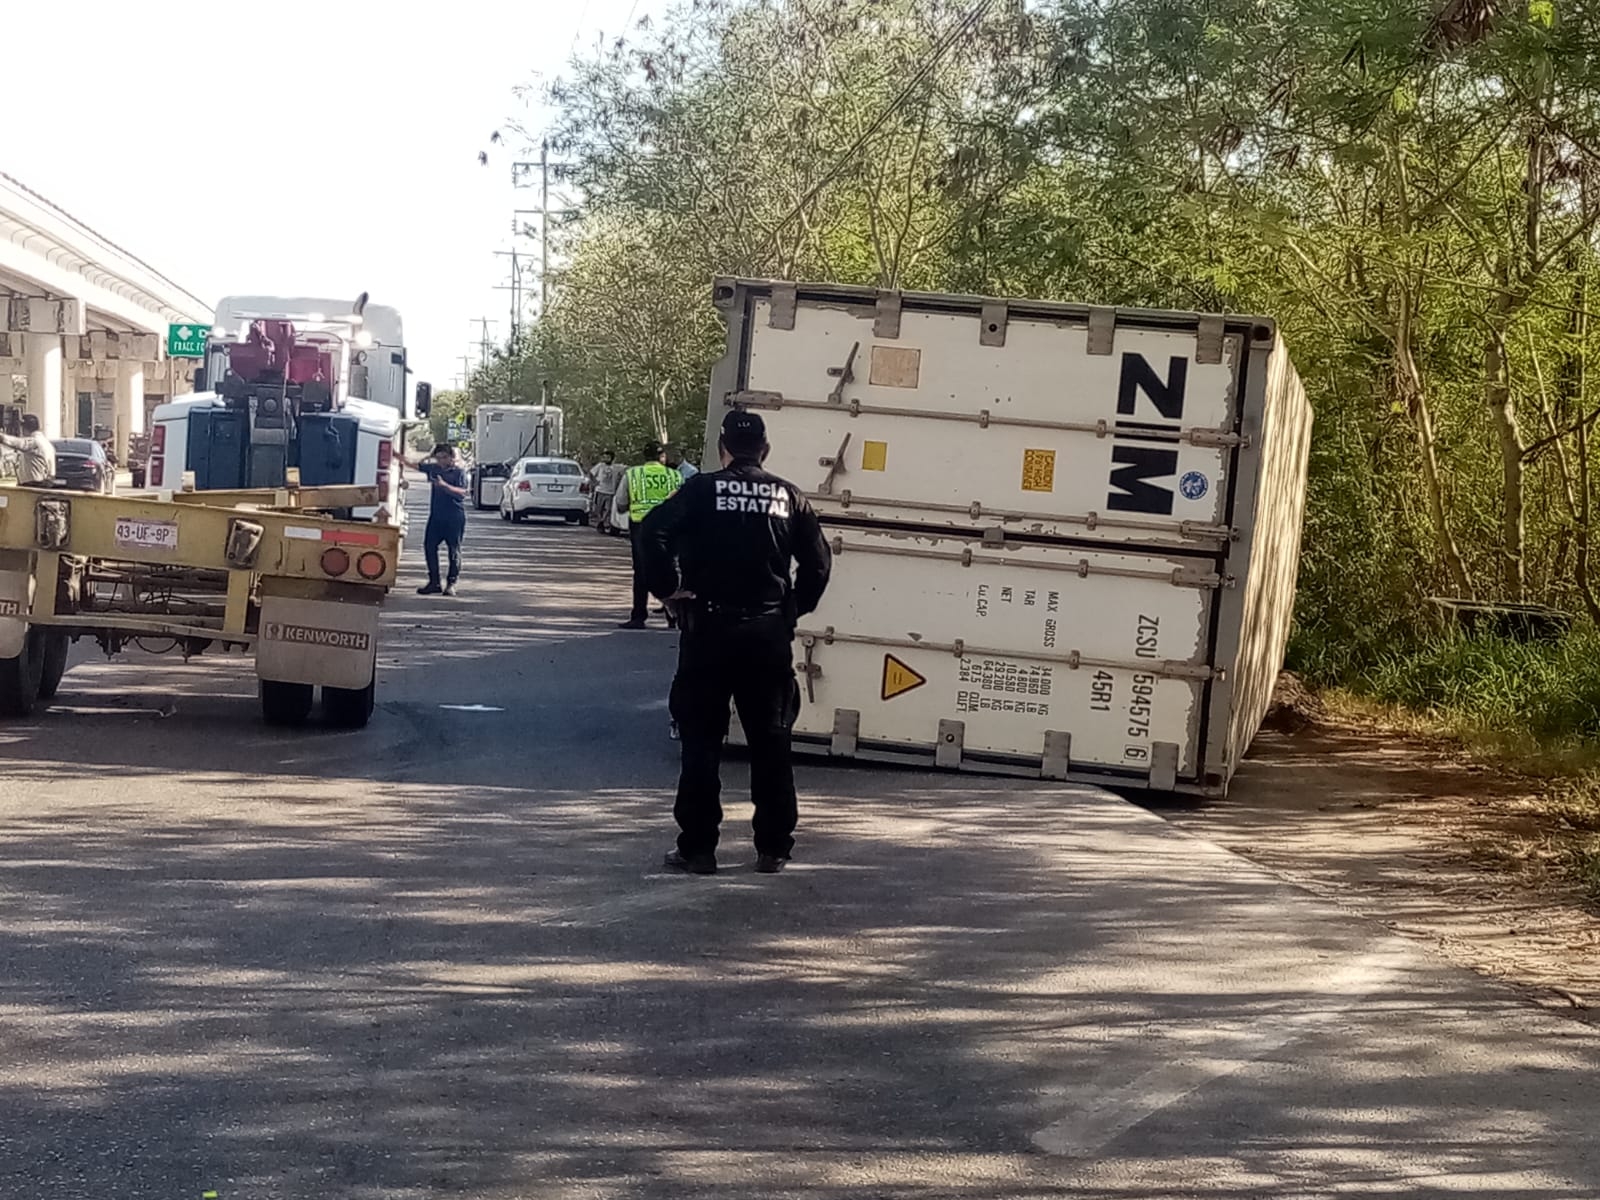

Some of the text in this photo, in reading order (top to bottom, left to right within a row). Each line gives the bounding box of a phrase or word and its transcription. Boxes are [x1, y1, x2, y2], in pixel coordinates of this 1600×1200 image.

[1107, 352, 1188, 515] ZIM
[645, 474, 667, 489] SSP
[716, 496, 789, 518] ESTATAL
[1001, 587, 1012, 603] NET
[1024, 590, 1036, 606] TAR
[1047, 591, 1059, 613] MAX
[285, 627, 366, 649] KENWORTH
[1044, 618, 1057, 648] GROSS
[1135, 614, 1160, 659] ZCSU
[1090, 670, 1113, 712] 45R1
[980, 698, 991, 709] LB
[991, 699, 1002, 711] KG
[1003, 700, 1014, 711] LB
[1014, 701, 1026, 713] KG
[1026, 702, 1037, 713] LB
[1037, 703, 1049, 716] KG
[1128, 673, 1154, 738] 594575
